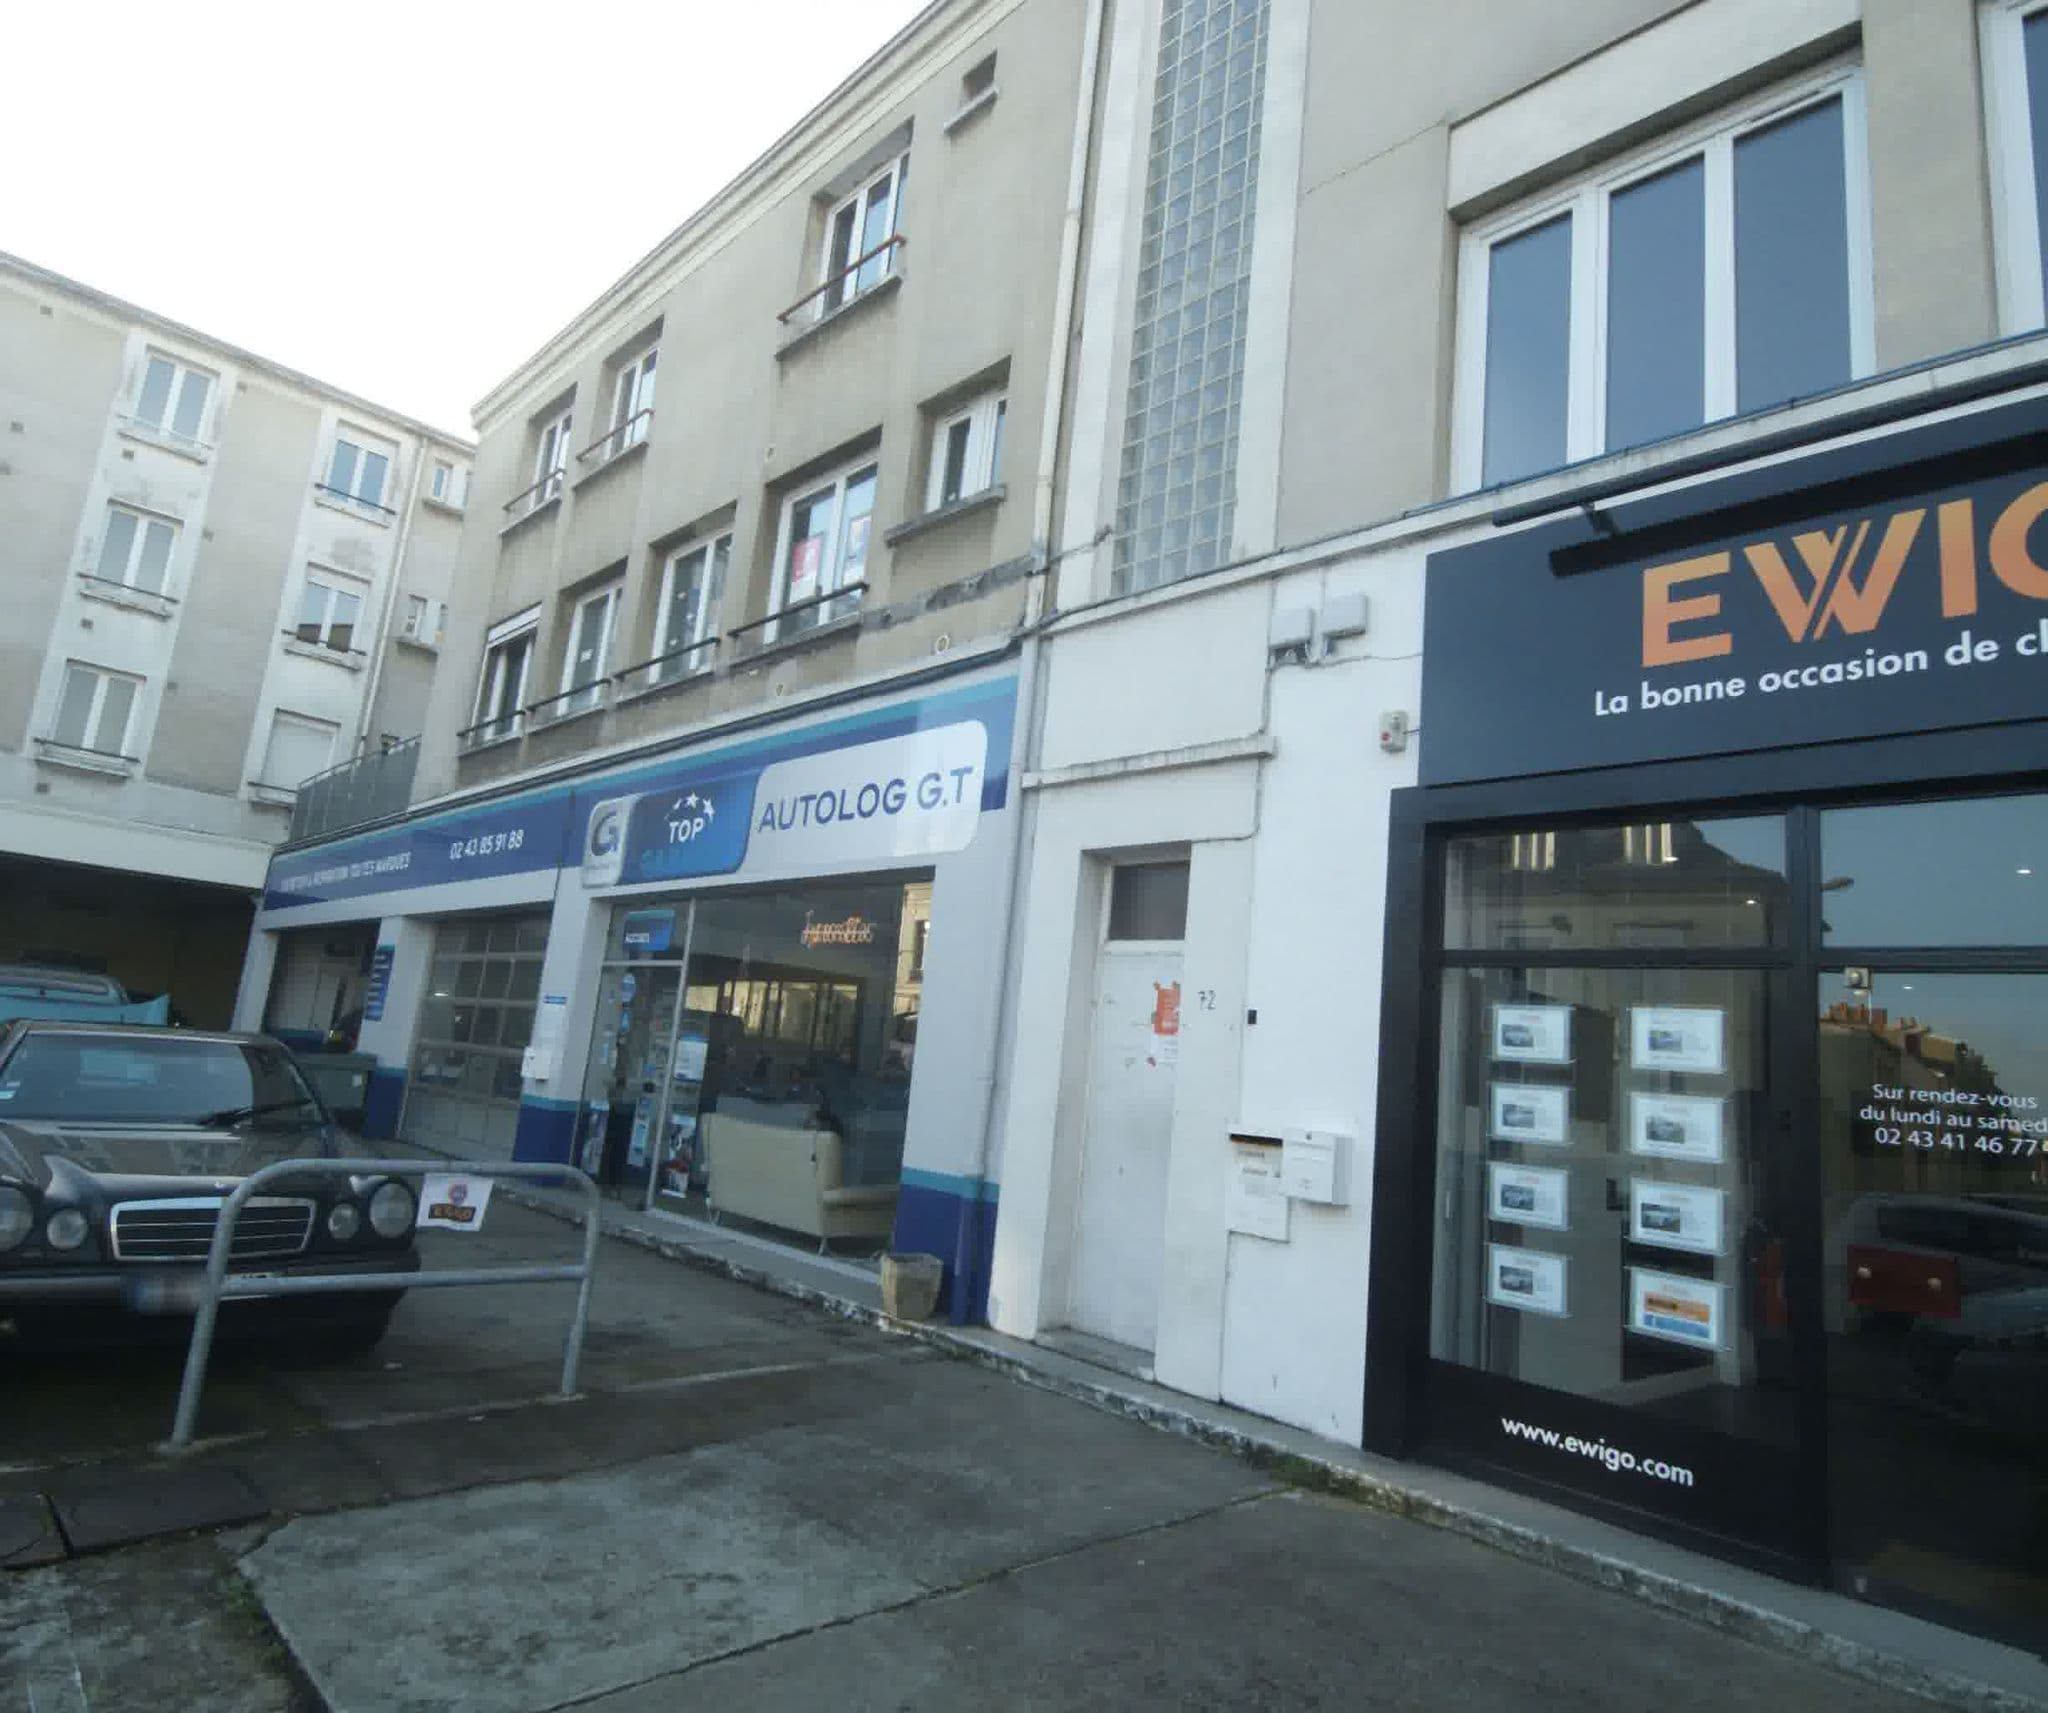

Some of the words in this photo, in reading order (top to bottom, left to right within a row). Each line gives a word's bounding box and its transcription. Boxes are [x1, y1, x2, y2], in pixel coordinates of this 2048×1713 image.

[1595, 689, 1628, 716] La
[1641, 680, 1746, 710] bonne
[1758, 649, 1928, 693] occasion
[1944, 630, 1999, 668] de
[758, 778, 907, 833] AUTOLOG
[917, 766, 973, 811] G.T
[669, 817, 704, 843] TOP
[450, 841, 464, 860] 02
[1872, 1084, 1904, 1100] Sur
[1909, 1088, 2038, 1110] rendez-vous
[1860, 1105, 1885, 1121] du
[1891, 1107, 1940, 1125] lundi
[1946, 1113, 1972, 1128] au
[1875, 1127, 1901, 1145] 02
[1907, 1130, 1934, 1148] 43
[1940, 1133, 1965, 1150] 41
[1974, 1135, 2004, 1154] 46
[2008, 1138, 2038, 1157] 77
[1502, 1418, 1694, 1486] www.ewigo.com
